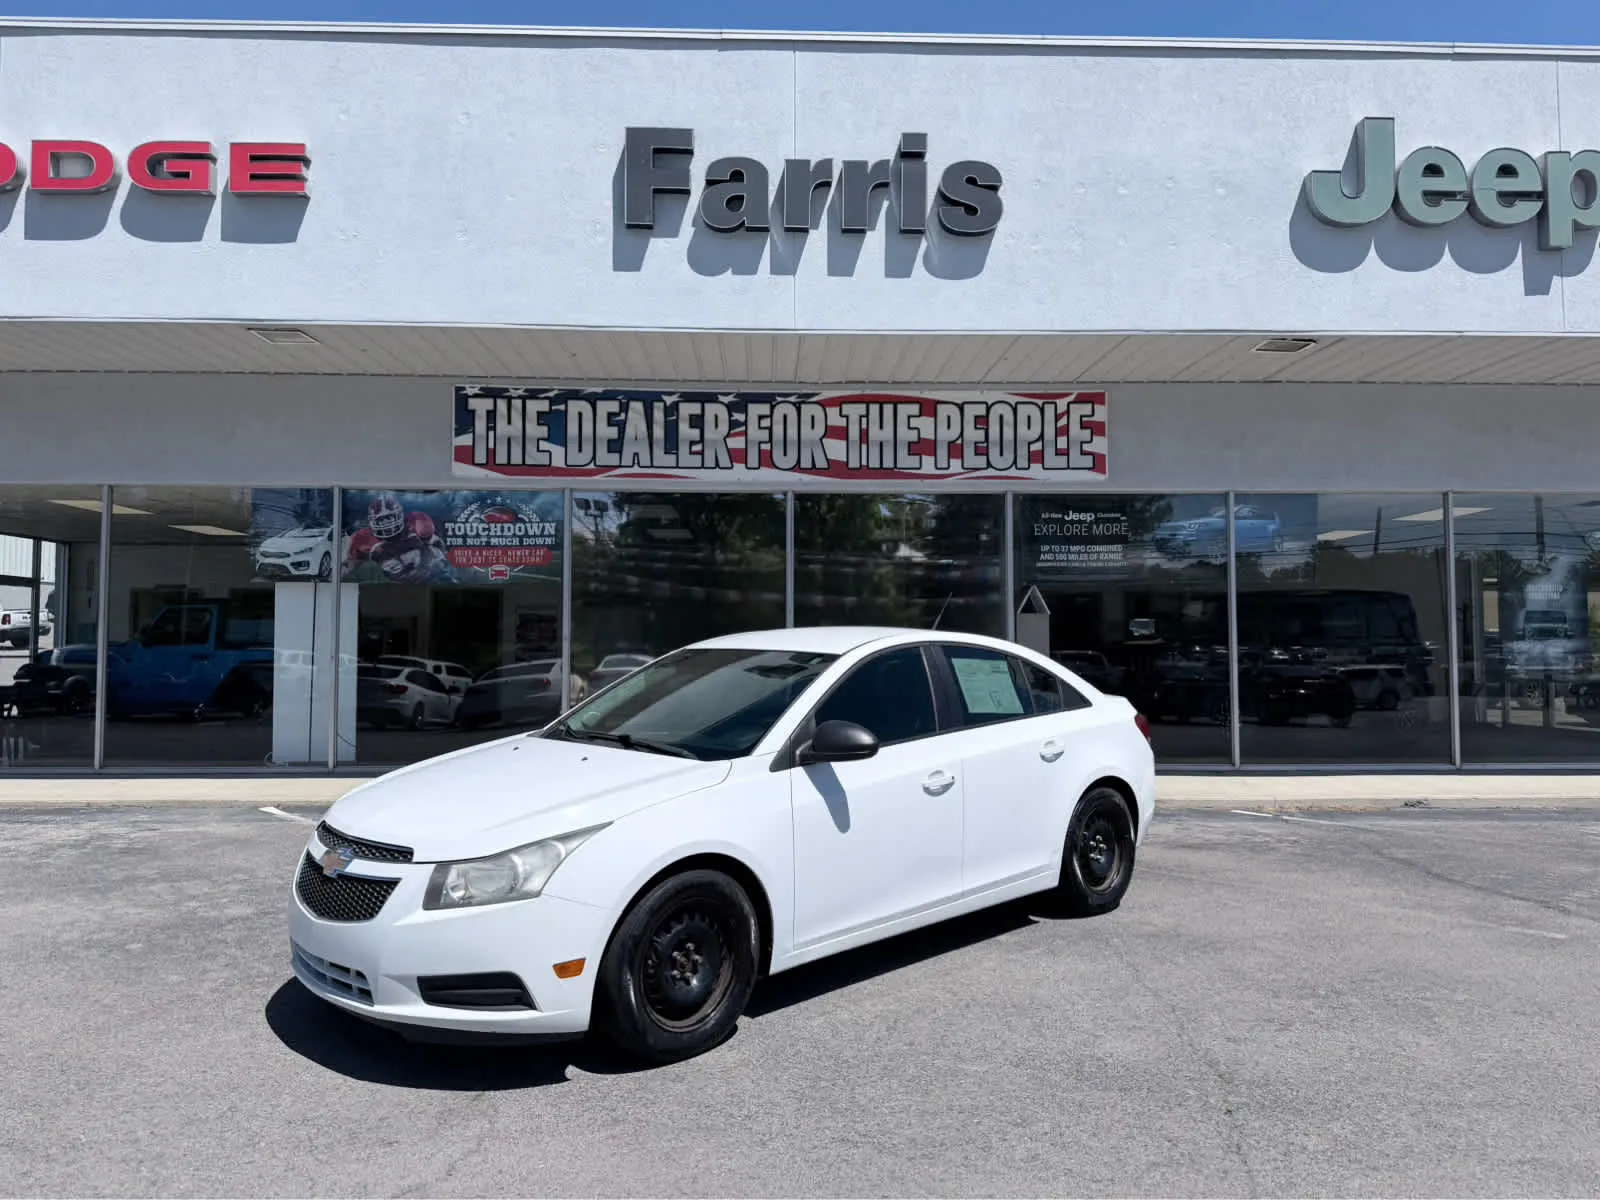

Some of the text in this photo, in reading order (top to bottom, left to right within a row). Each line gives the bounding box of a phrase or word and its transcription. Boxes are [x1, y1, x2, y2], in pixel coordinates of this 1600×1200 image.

[0, 140, 310, 199] DGE
[624, 127, 1004, 236] Farris
[1304, 117, 1600, 250] Jeep
[467, 396, 1096, 471] THE DEALER FOR THE PEOPLE
[1064, 510, 1095, 522] Jeep
[445, 522, 556, 536] TOUCHDOWN
[1034, 522, 1129, 536] EXPLORE MORE
[446, 537, 556, 546] FOR NOT MUCH DOWN!
[1040, 544, 1050, 552] UP
[1051, 544, 1060, 552] TO
[1040, 553, 1055, 561] AND
[1068, 553, 1089, 561] MILES
[1089, 552, 1098, 561] OF
